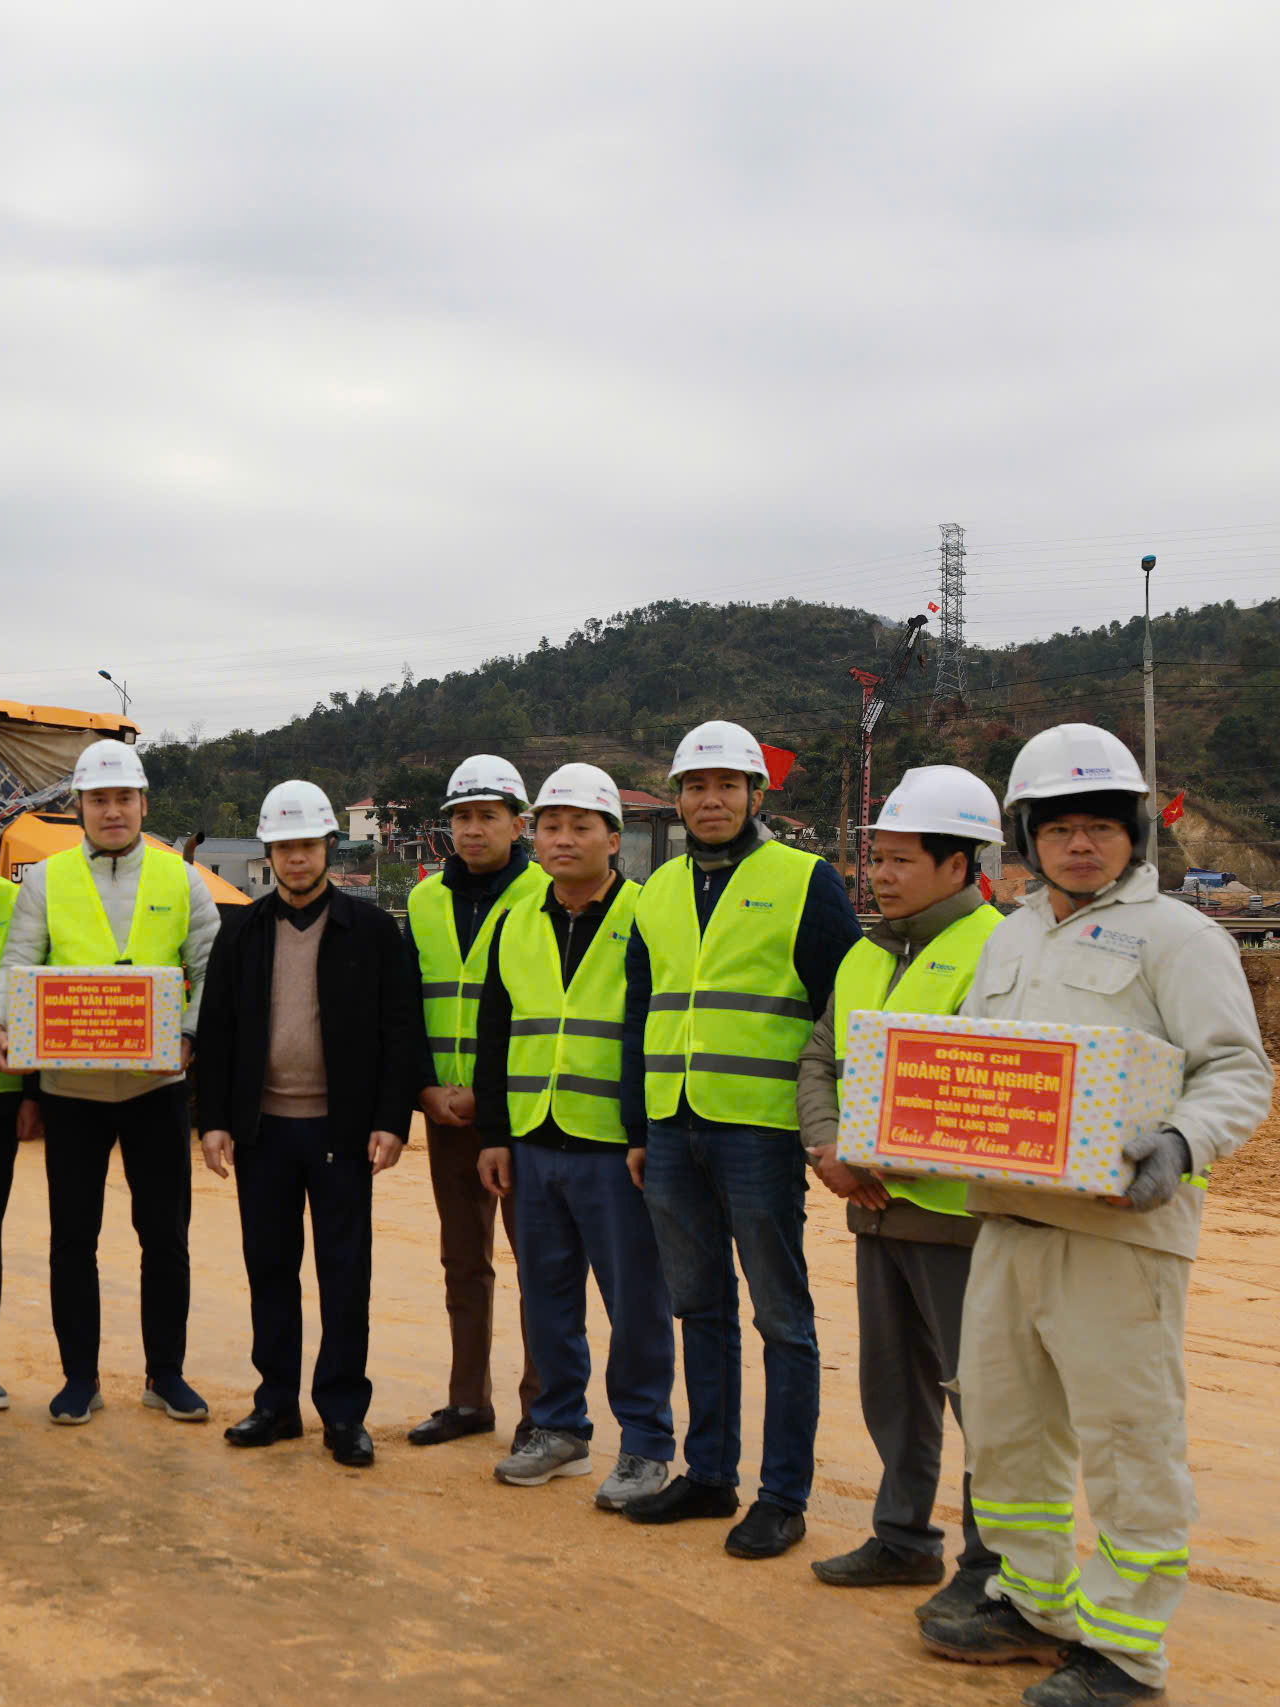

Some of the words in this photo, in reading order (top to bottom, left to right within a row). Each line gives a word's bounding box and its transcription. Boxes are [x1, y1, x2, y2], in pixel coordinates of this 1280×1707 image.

[989, 1052, 1021, 1066] CHÍ
[897, 1060, 951, 1081] HOÀNG
[955, 1064, 989, 1085] VĂN
[992, 1070, 1061, 1094] NGHIỆM
